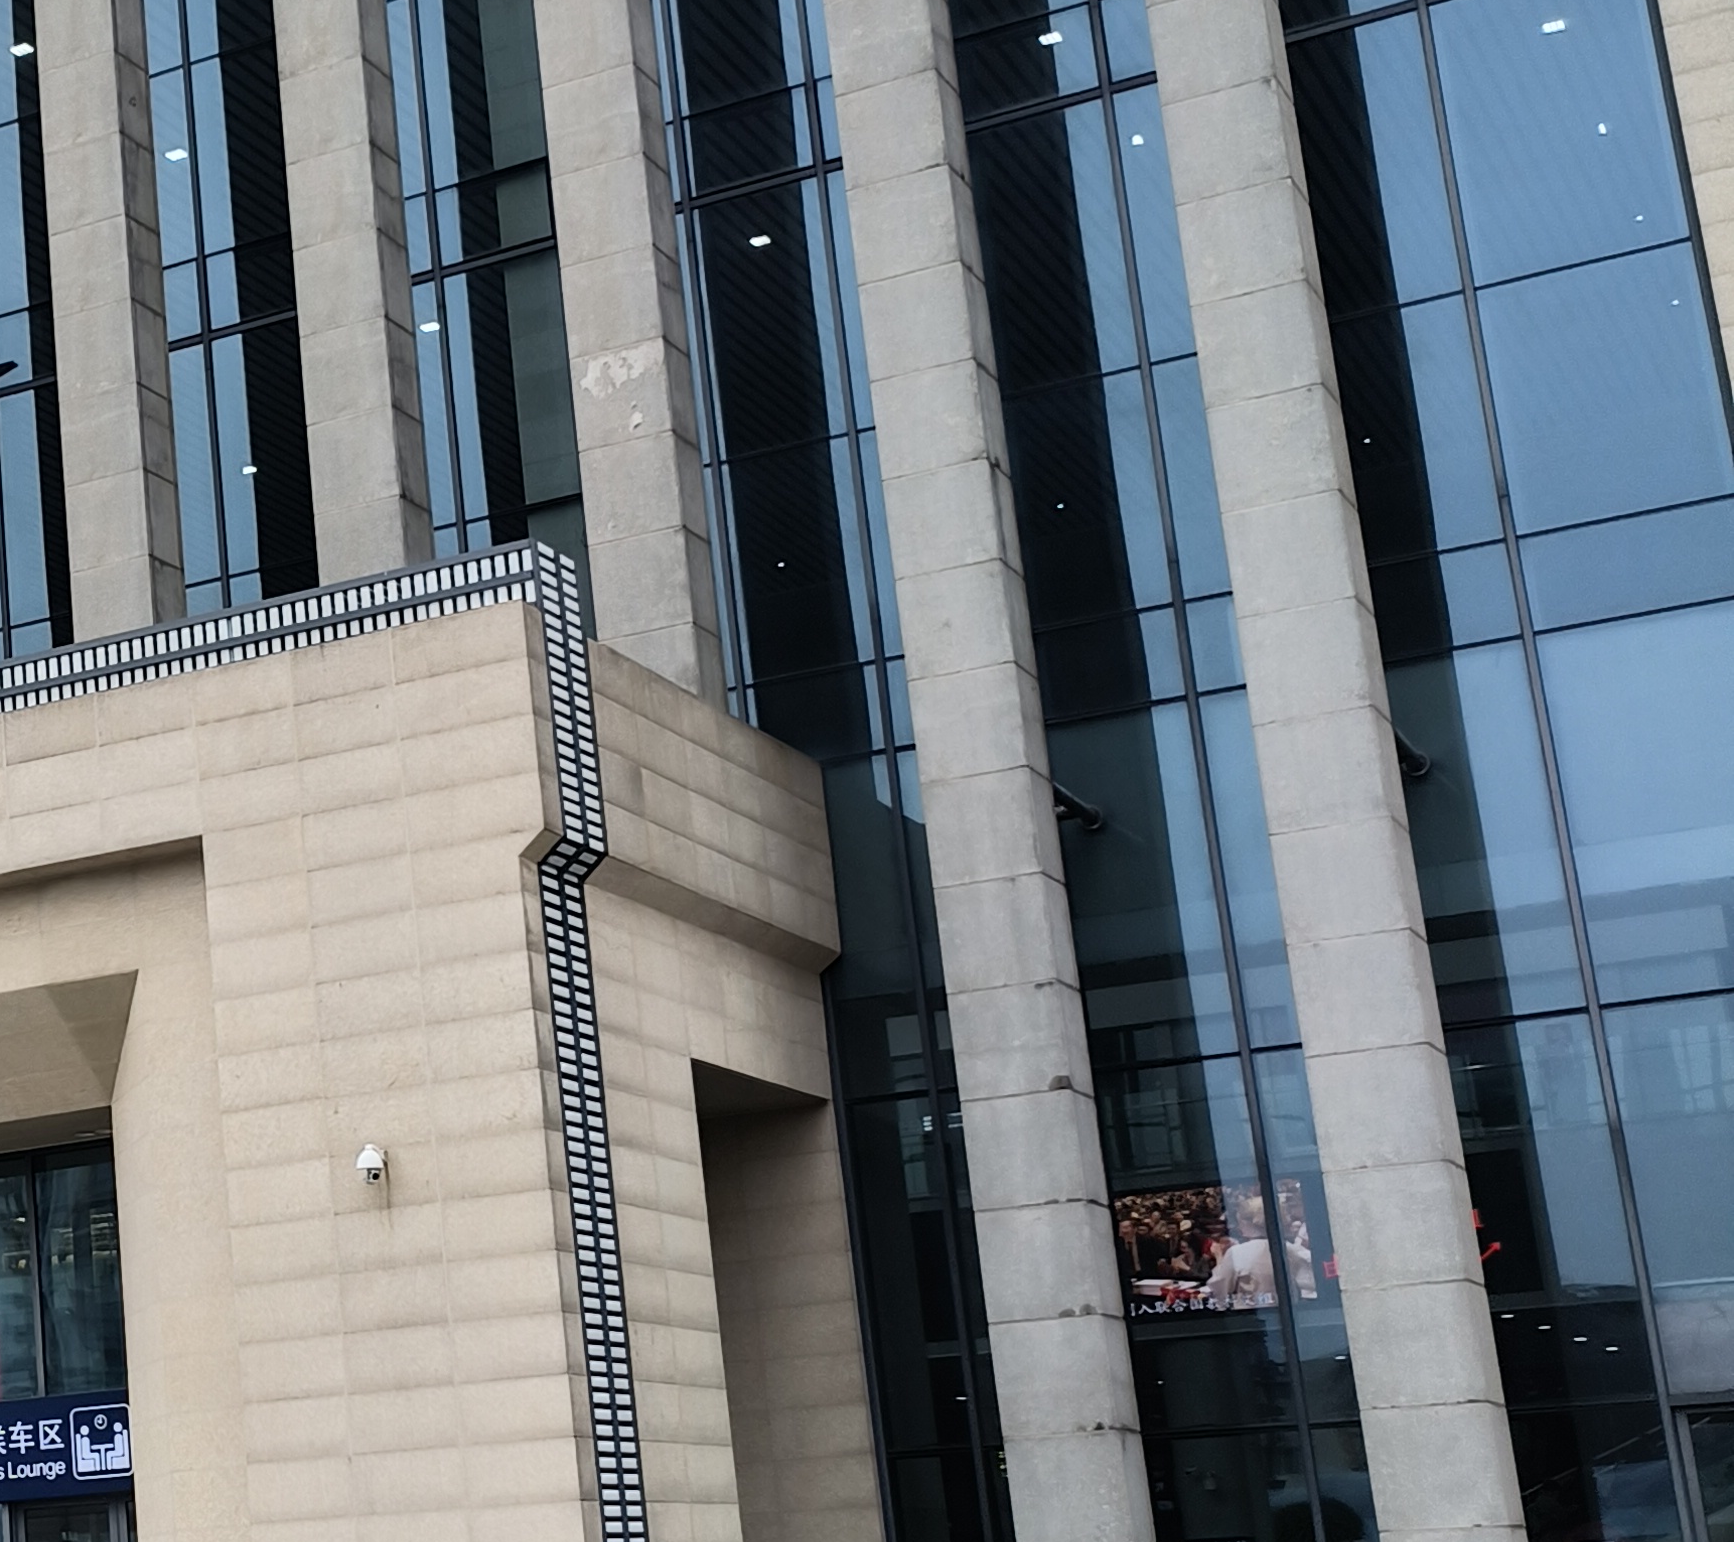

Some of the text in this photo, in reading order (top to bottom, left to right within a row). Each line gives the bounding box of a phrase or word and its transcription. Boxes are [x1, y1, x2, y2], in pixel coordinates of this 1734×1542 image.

[1130, 1291, 1275, 1317] 入联合国教科文组
[7, 1461, 66, 1481] Lounge
